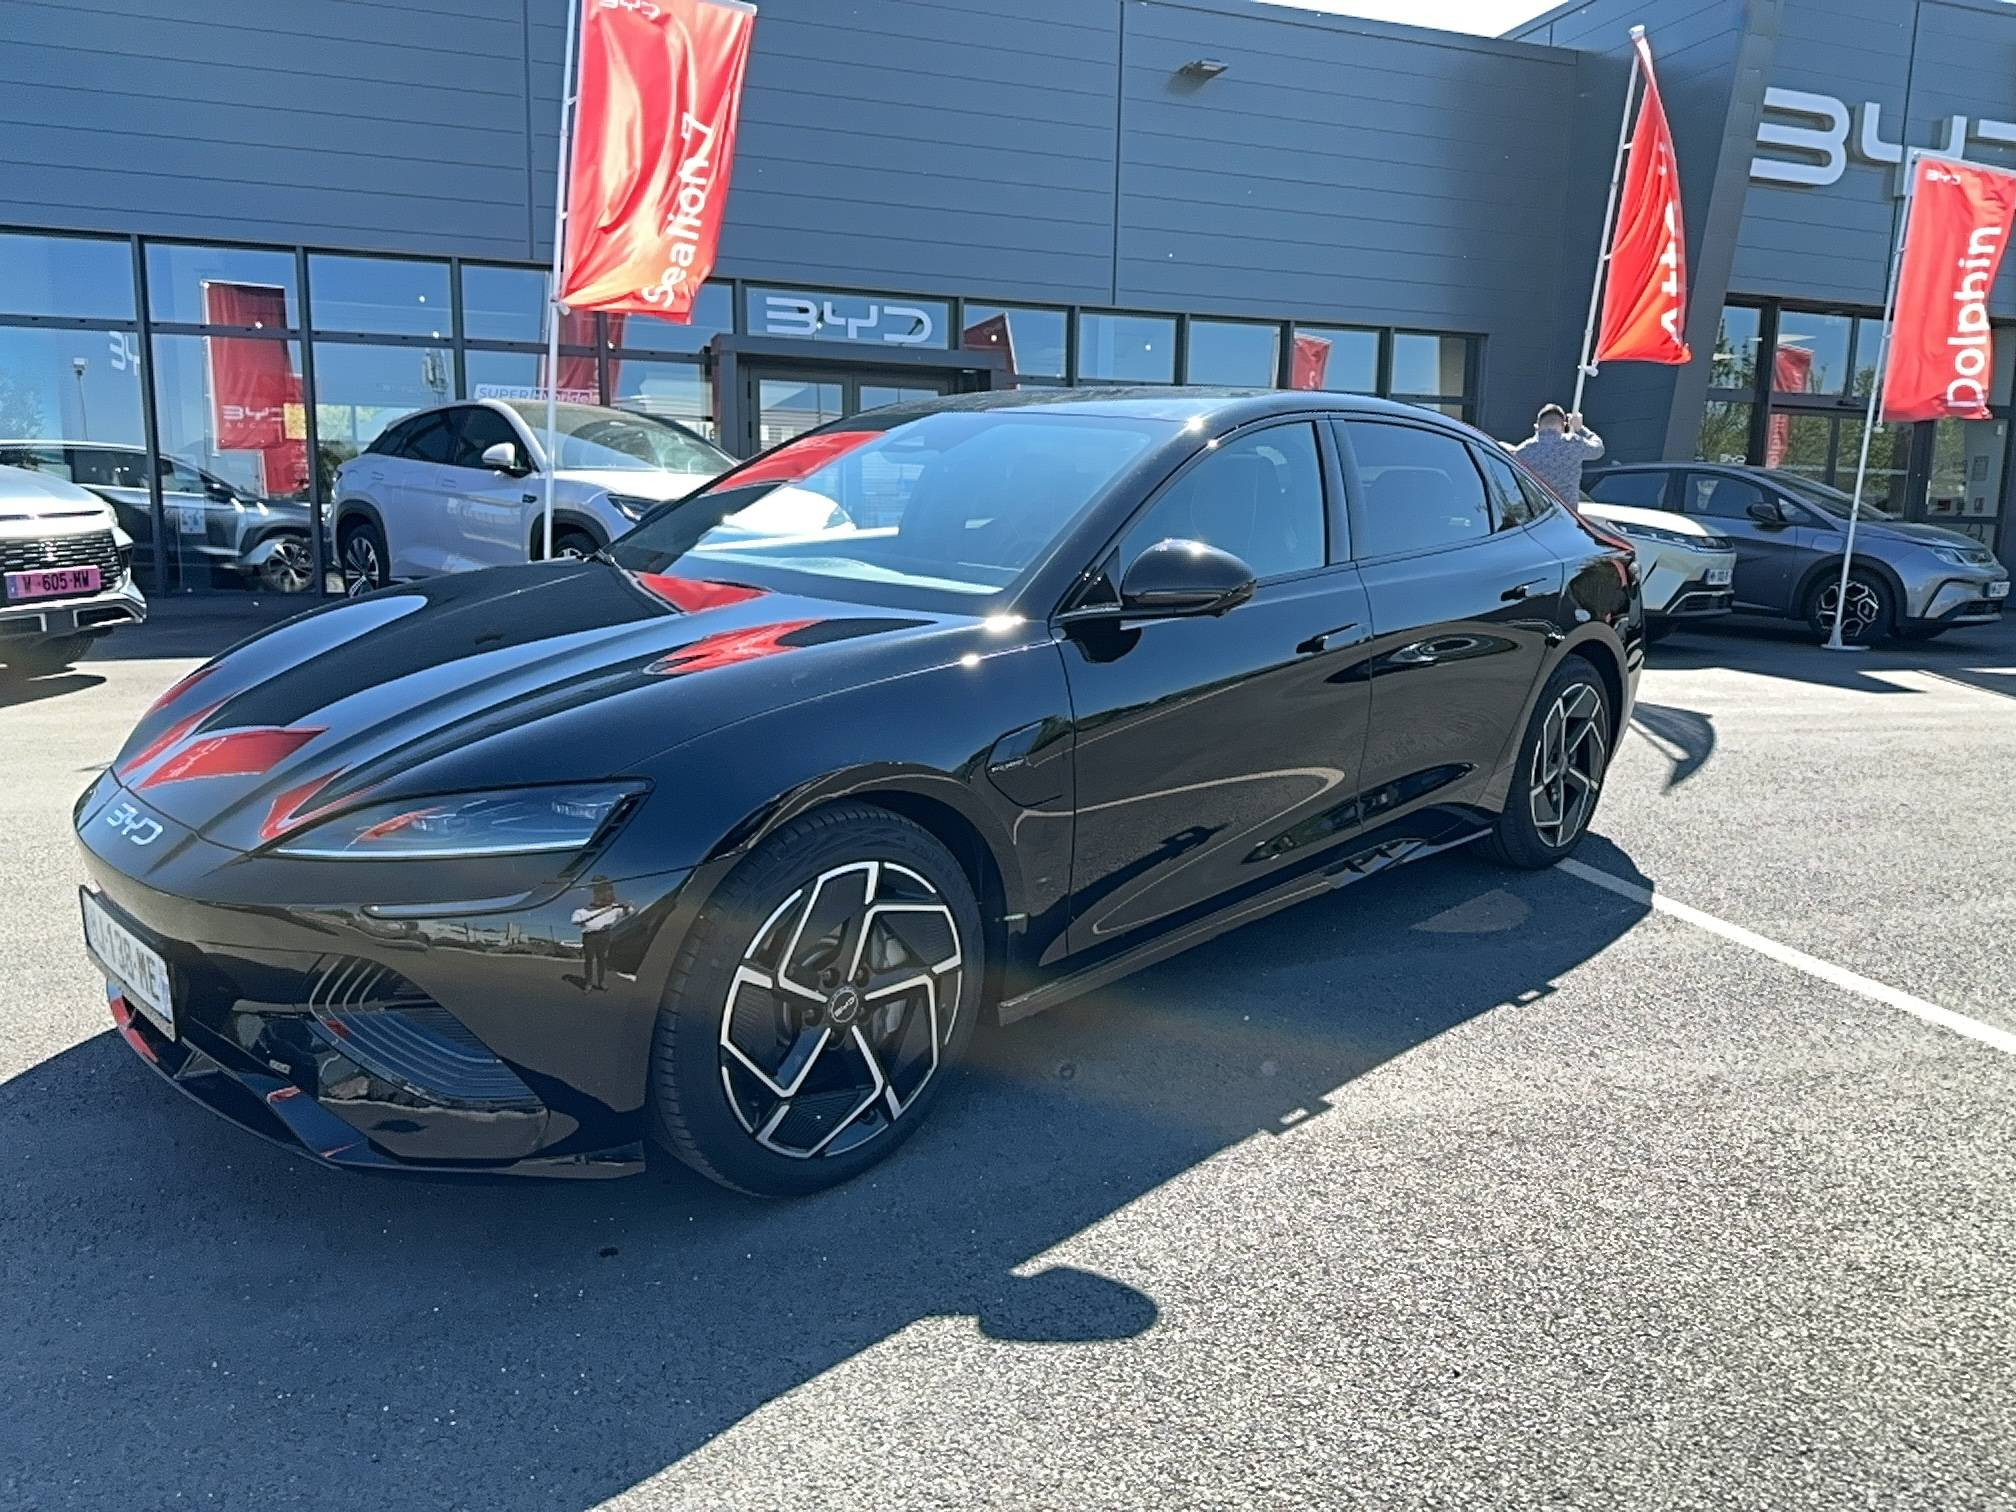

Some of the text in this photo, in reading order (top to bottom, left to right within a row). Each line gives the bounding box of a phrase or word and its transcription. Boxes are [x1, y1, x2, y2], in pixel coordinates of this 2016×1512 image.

[641, 111, 715, 309] Sealion 7
[766, 296, 933, 344] BYD
[1945, 226, 2003, 408] Dolphin
[106, 802, 163, 846] BYD
